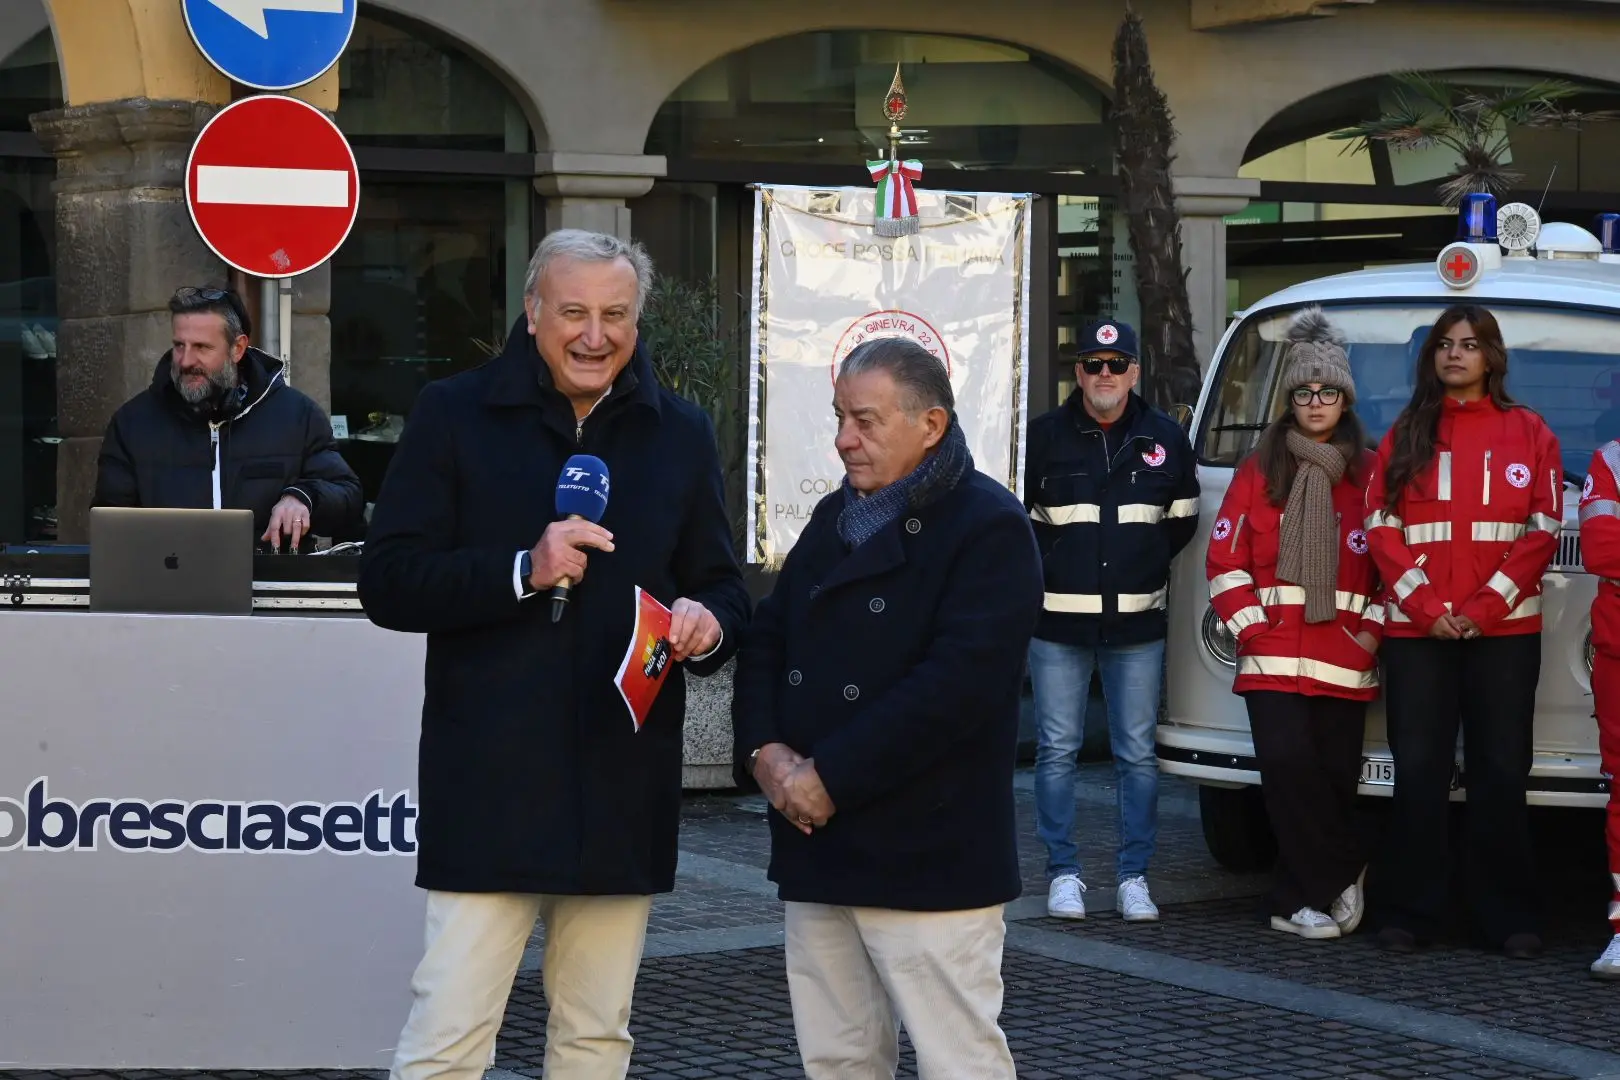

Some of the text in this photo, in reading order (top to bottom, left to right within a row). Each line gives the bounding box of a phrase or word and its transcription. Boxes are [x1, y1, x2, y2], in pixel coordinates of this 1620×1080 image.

[853, 244, 919, 262] ROSSA
[865, 318, 915, 335] GINEVRA
[917, 331, 932, 347] 22
[799, 478, 843, 494] COM
[775, 503, 815, 520] PALA
[1367, 763, 1392, 780] 115
[0, 778, 419, 854] obresciasett
